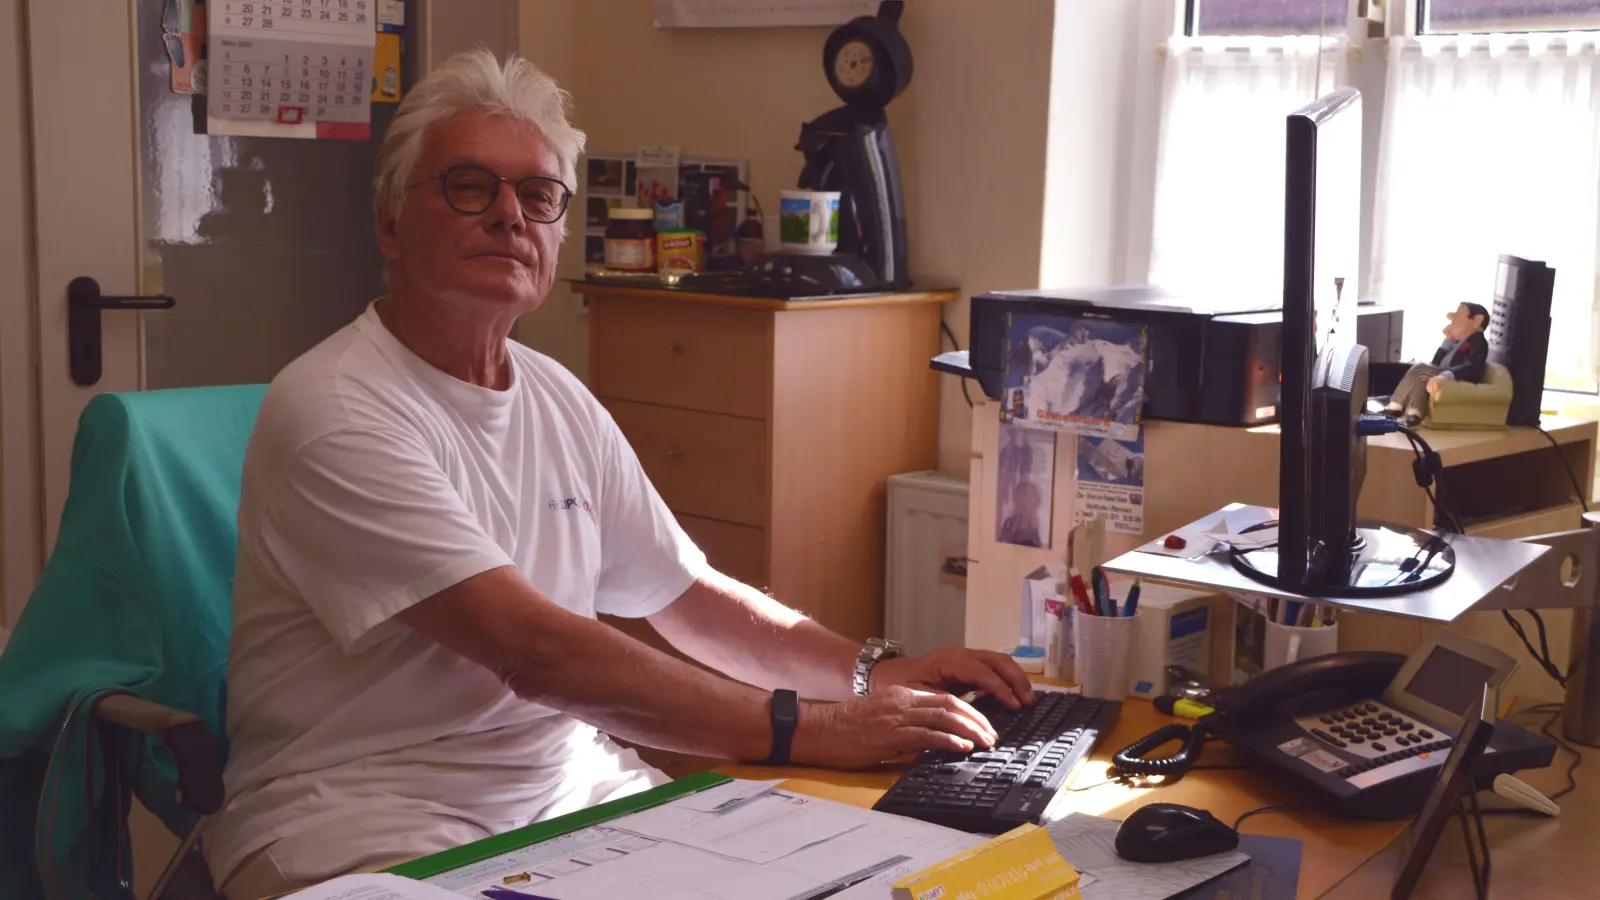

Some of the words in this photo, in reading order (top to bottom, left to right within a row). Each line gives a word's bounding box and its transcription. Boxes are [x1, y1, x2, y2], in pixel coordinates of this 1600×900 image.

[242, 3, 253, 14] 20
[262, 5, 272, 15] 21
[282, 7, 292, 17] 22
[301, 8, 312, 18] 23
[320, 10, 330, 20] 24
[338, 12, 348, 21] 25
[356, 1, 366, 10] 19
[242, 16, 253, 26] 27
[262, 18, 273, 28] 28
[284, 54, 289, 64] 1
[303, 55, 309, 65] 2
[321, 56, 328, 66] 3
[341, 57, 346, 67] 4
[244, 64, 250, 74] 6
[264, 65, 270, 75] 7
[302, 68, 309, 77] 9
[319, 69, 330, 79] 10
[337, 70, 346, 79] 11
[242, 77, 253, 88] 13
[261, 78, 271, 88] 14
[281, 80, 292, 90] 15
[300, 81, 310, 91] 16
[319, 82, 329, 92] 17
[336, 83, 346, 92] 18
[241, 90, 252, 100] 20
[260, 91, 270, 101] 21
[279, 92, 291, 102] 22
[299, 94, 310, 103] 23
[241, 103, 252, 113] 27
